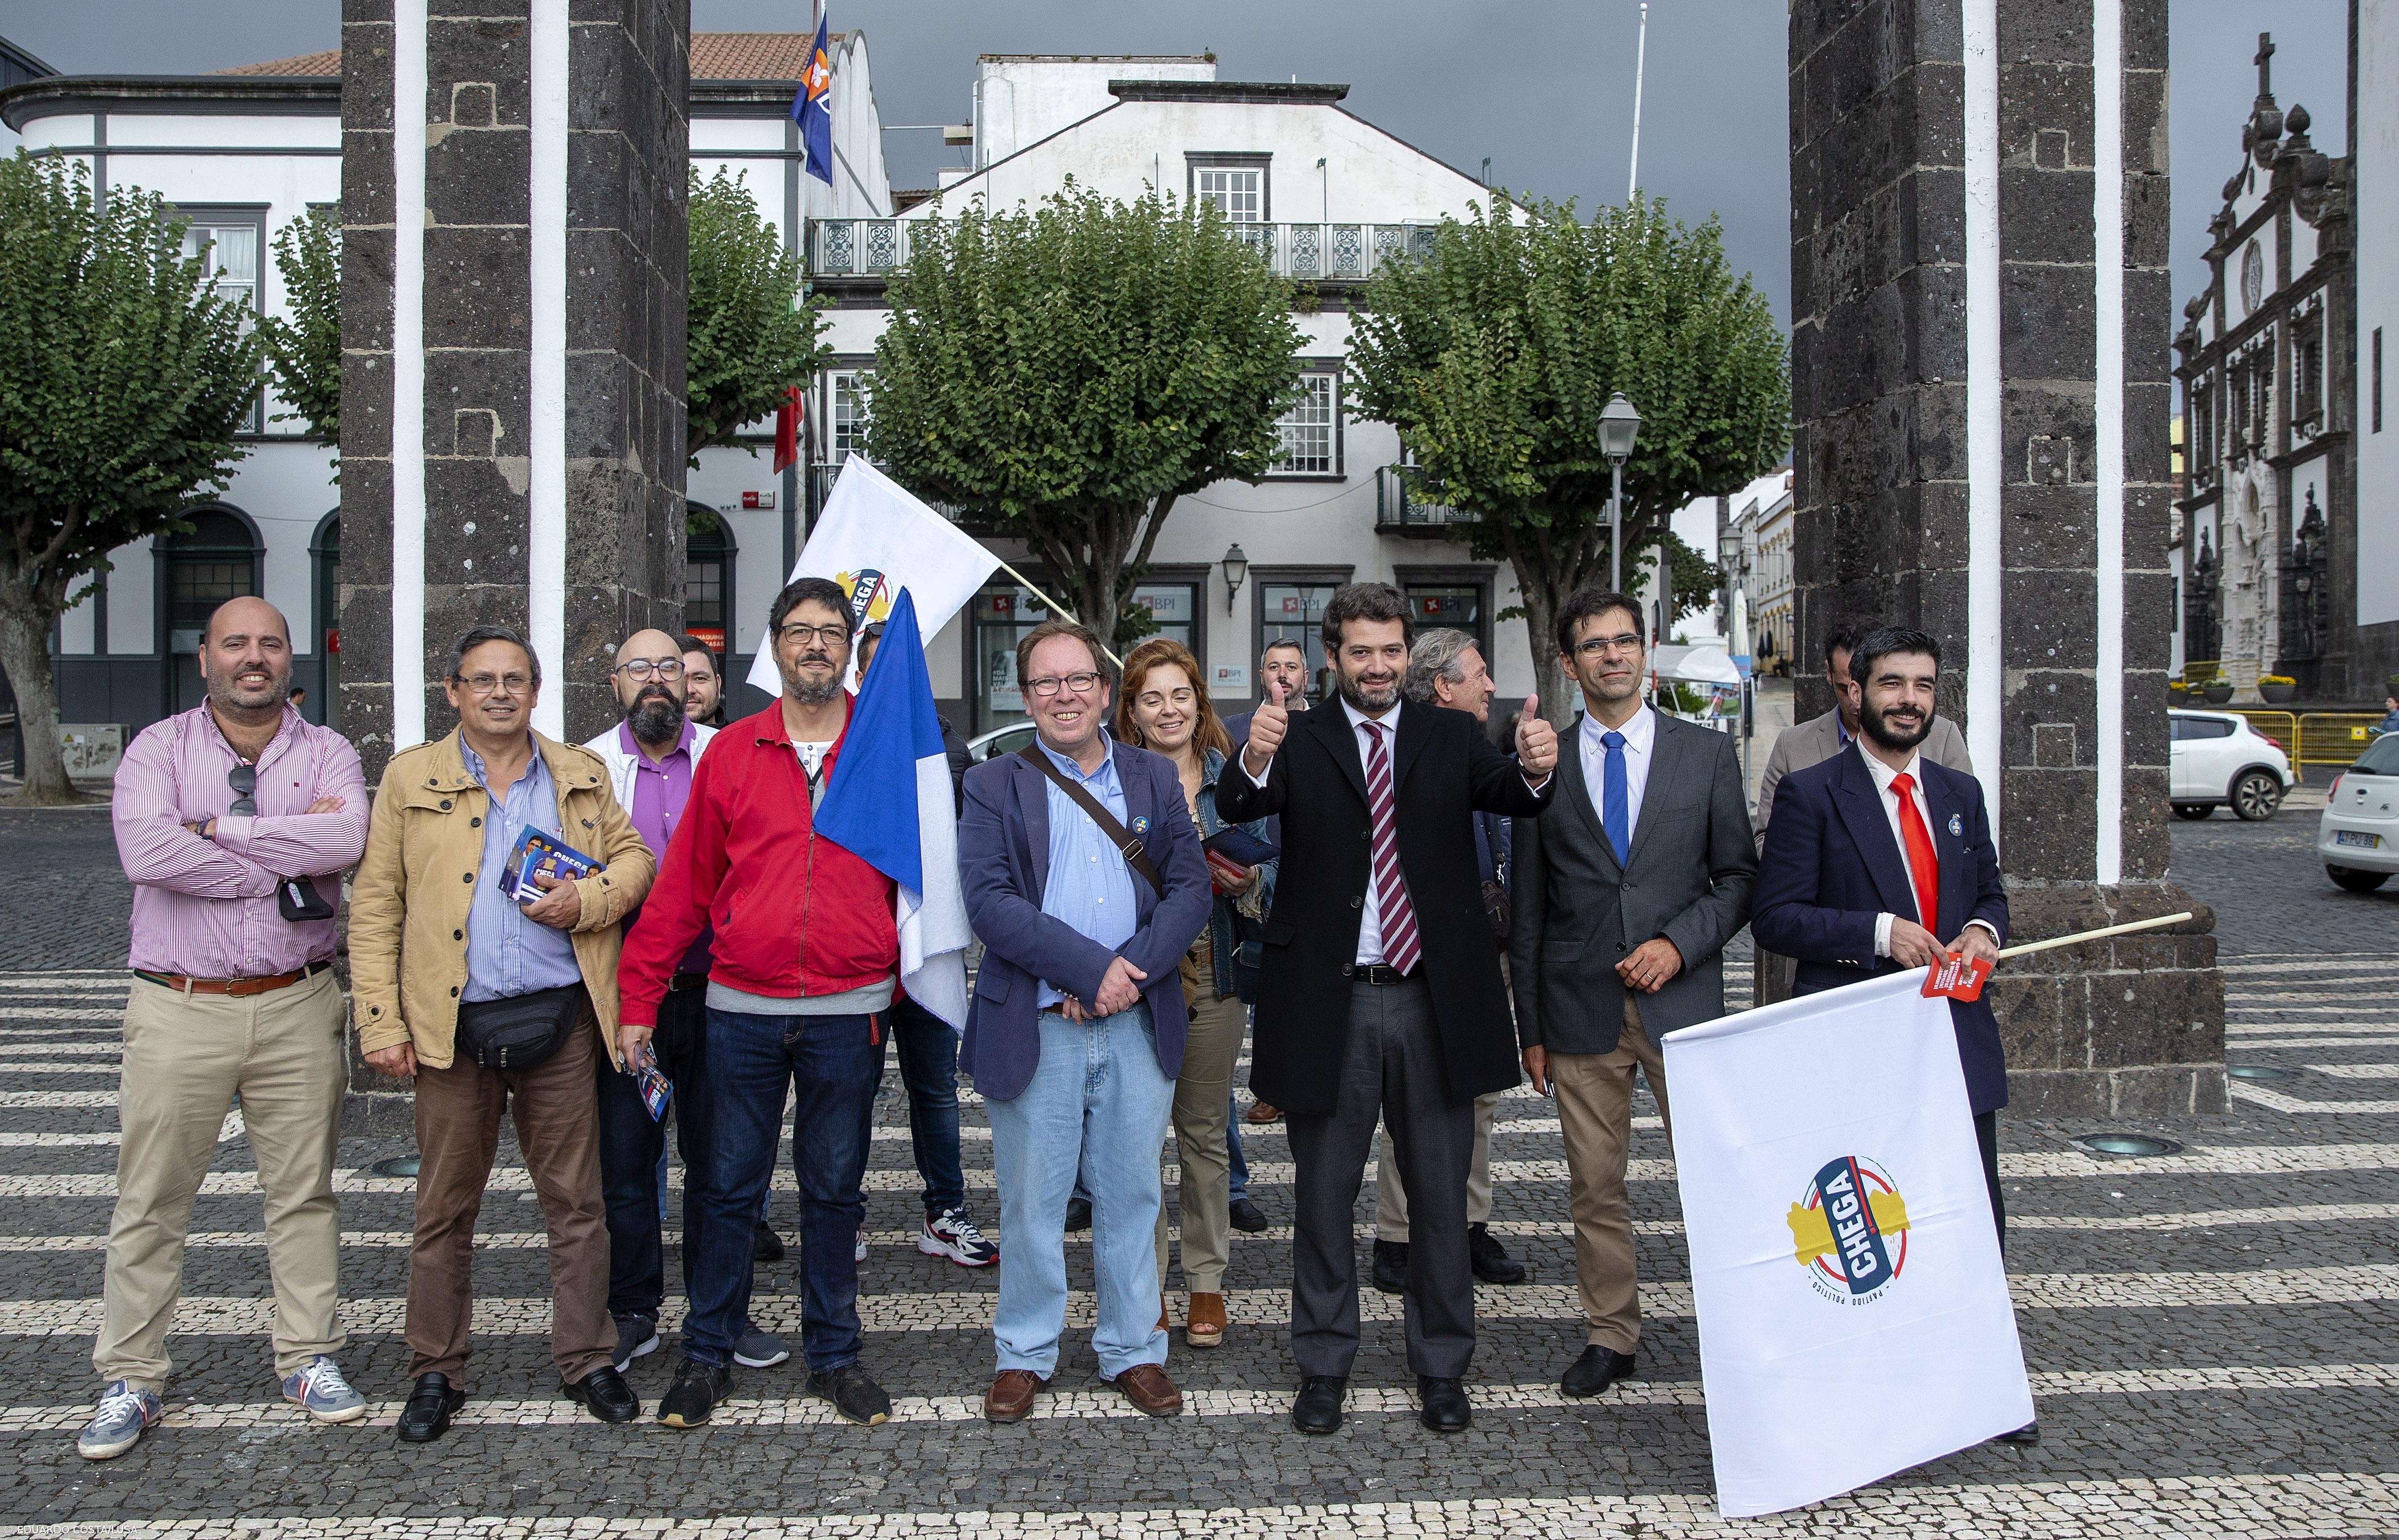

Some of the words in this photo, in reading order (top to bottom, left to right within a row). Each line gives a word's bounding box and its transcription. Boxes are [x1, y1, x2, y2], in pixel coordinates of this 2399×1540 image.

[852, 577, 878, 616] HEGA
[1155, 598, 1174, 610] BPI
[1300, 599, 1319, 610] BPI
[1825, 1168, 1877, 1279] CHEGA
[1812, 1281, 1845, 1304] POLÍTICO
[1852, 1290, 1883, 1306] PARTIDO
